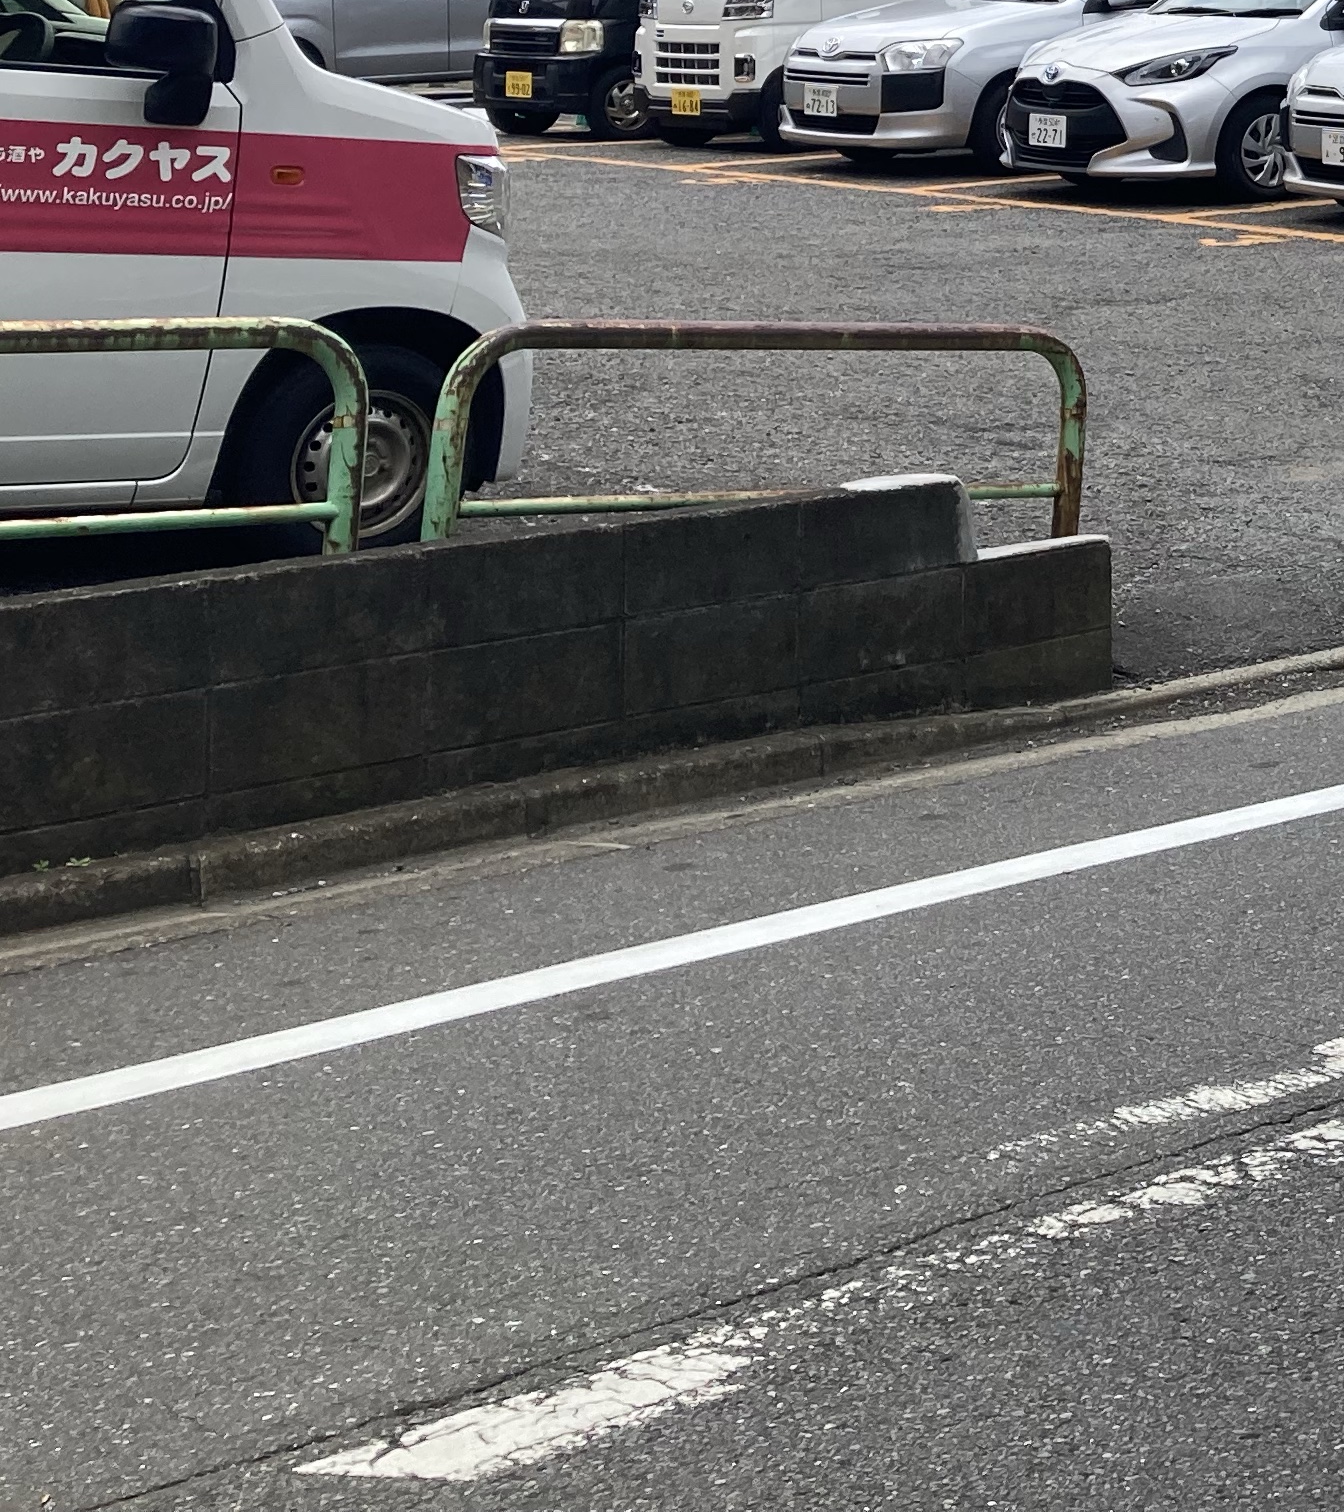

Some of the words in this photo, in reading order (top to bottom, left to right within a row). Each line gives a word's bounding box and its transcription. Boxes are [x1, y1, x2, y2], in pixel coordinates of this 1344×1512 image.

[1036, 127, 1063, 145] 22-71
[53, 136, 232, 183] カクヤス
